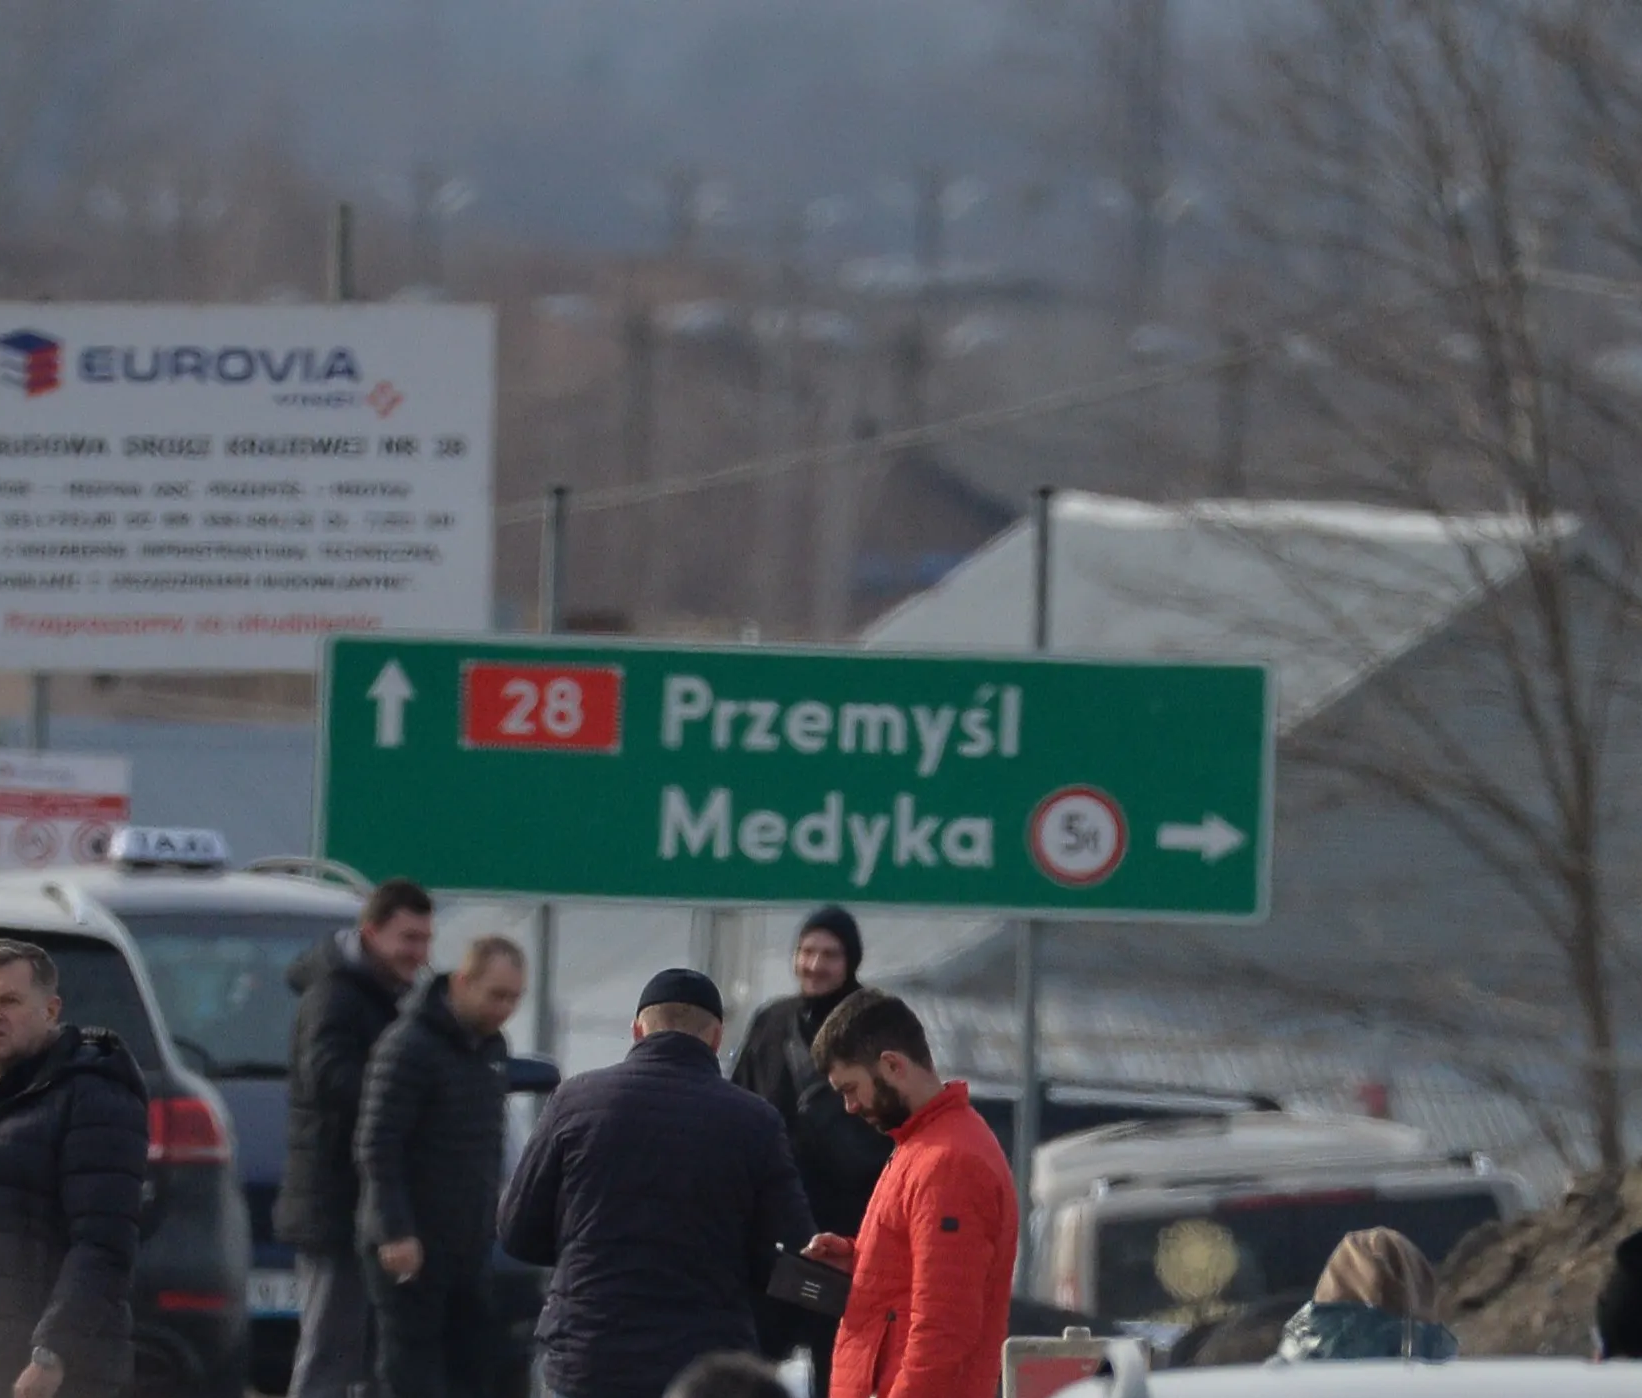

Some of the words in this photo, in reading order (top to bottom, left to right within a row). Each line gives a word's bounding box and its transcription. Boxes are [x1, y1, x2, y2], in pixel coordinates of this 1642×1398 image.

[77, 344, 360, 386] EUROVIA
[498, 677, 587, 738] 28
[659, 673, 1024, 778] Przemyśl
[657, 785, 996, 888] Medyka
